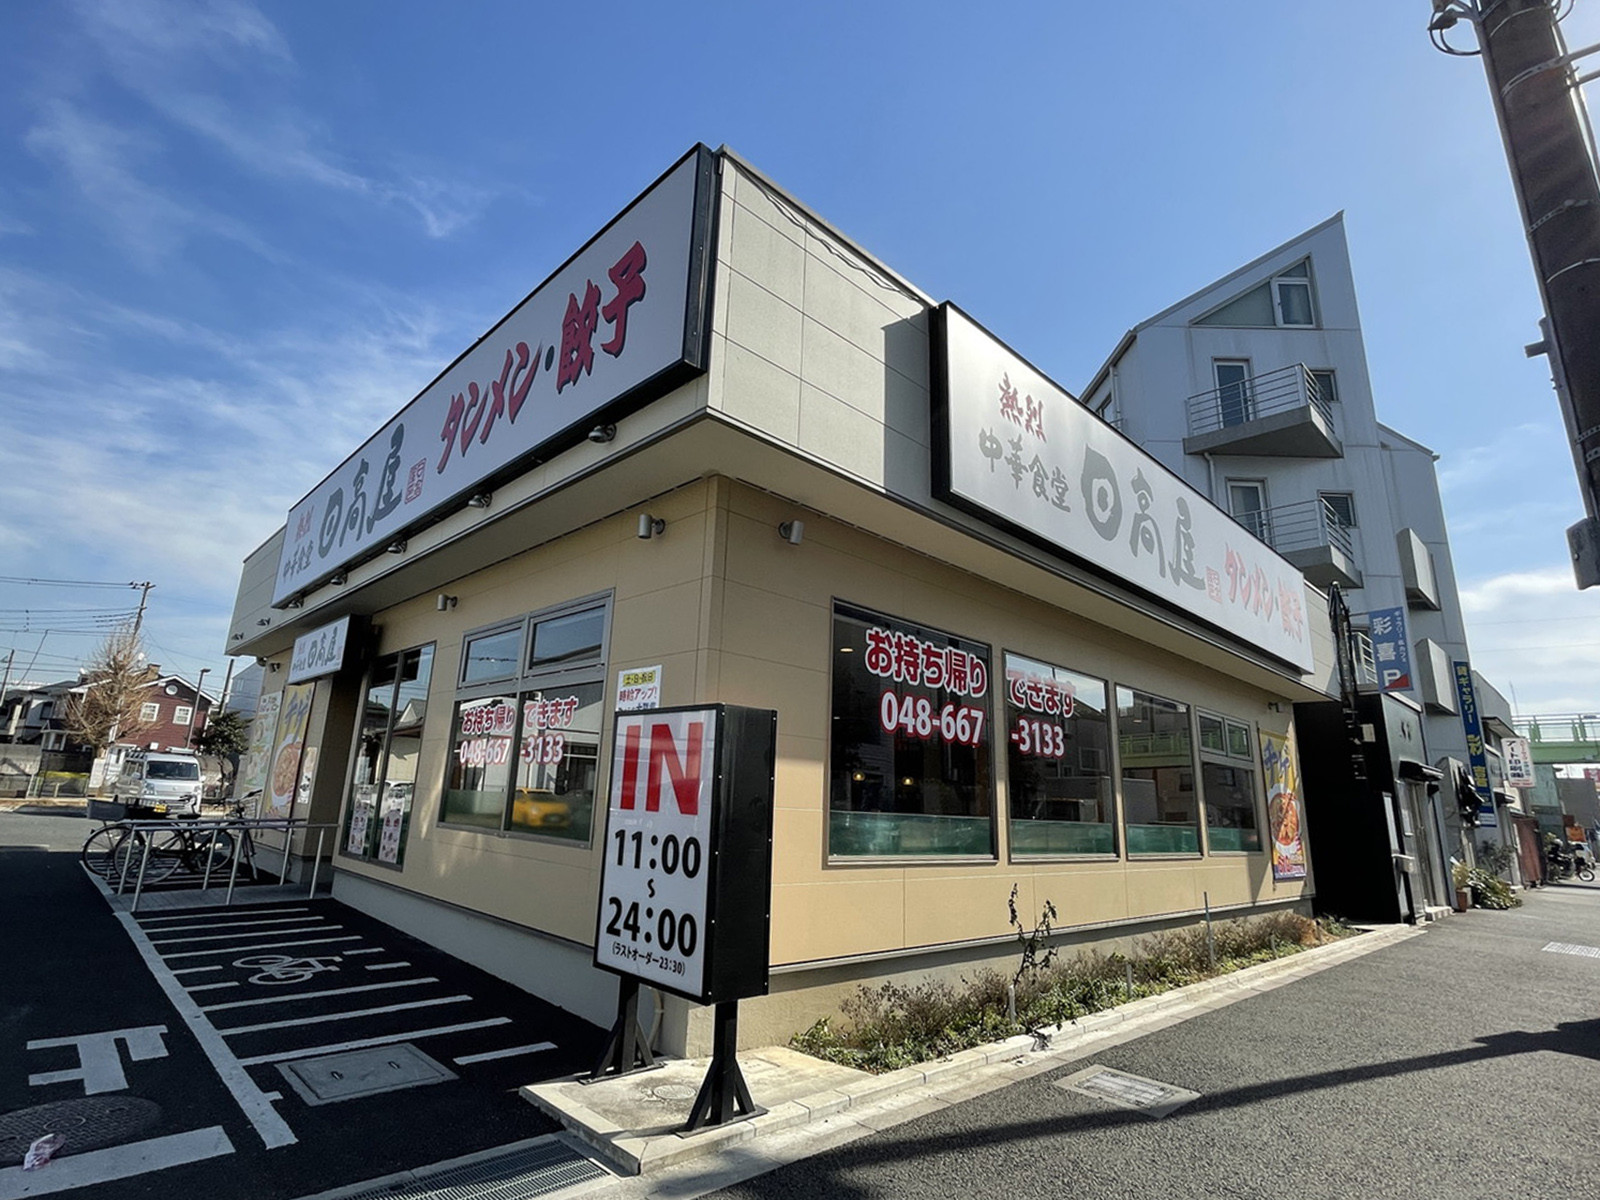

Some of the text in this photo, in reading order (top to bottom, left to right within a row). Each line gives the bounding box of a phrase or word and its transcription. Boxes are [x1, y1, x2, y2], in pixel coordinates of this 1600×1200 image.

[999, 372, 1047, 443] 熱烈
[317, 423, 404, 559] 日高屋
[978, 427, 1071, 513] 中華食堂
[1080, 443, 1205, 591] 日高屋
[865, 626, 1077, 719] お持ち帰り できます
[461, 695, 579, 736] お持ち帰り できます
[879, 688, 1068, 758] 048-667 -3133
[459, 735, 513, 768] 048-667
[620, 722, 704, 815] IN
[615, 829, 702, 879] 11:00
[606, 897, 698, 958] 24:00
[612, 942, 686, 977] (ラストオーダー23:30)
